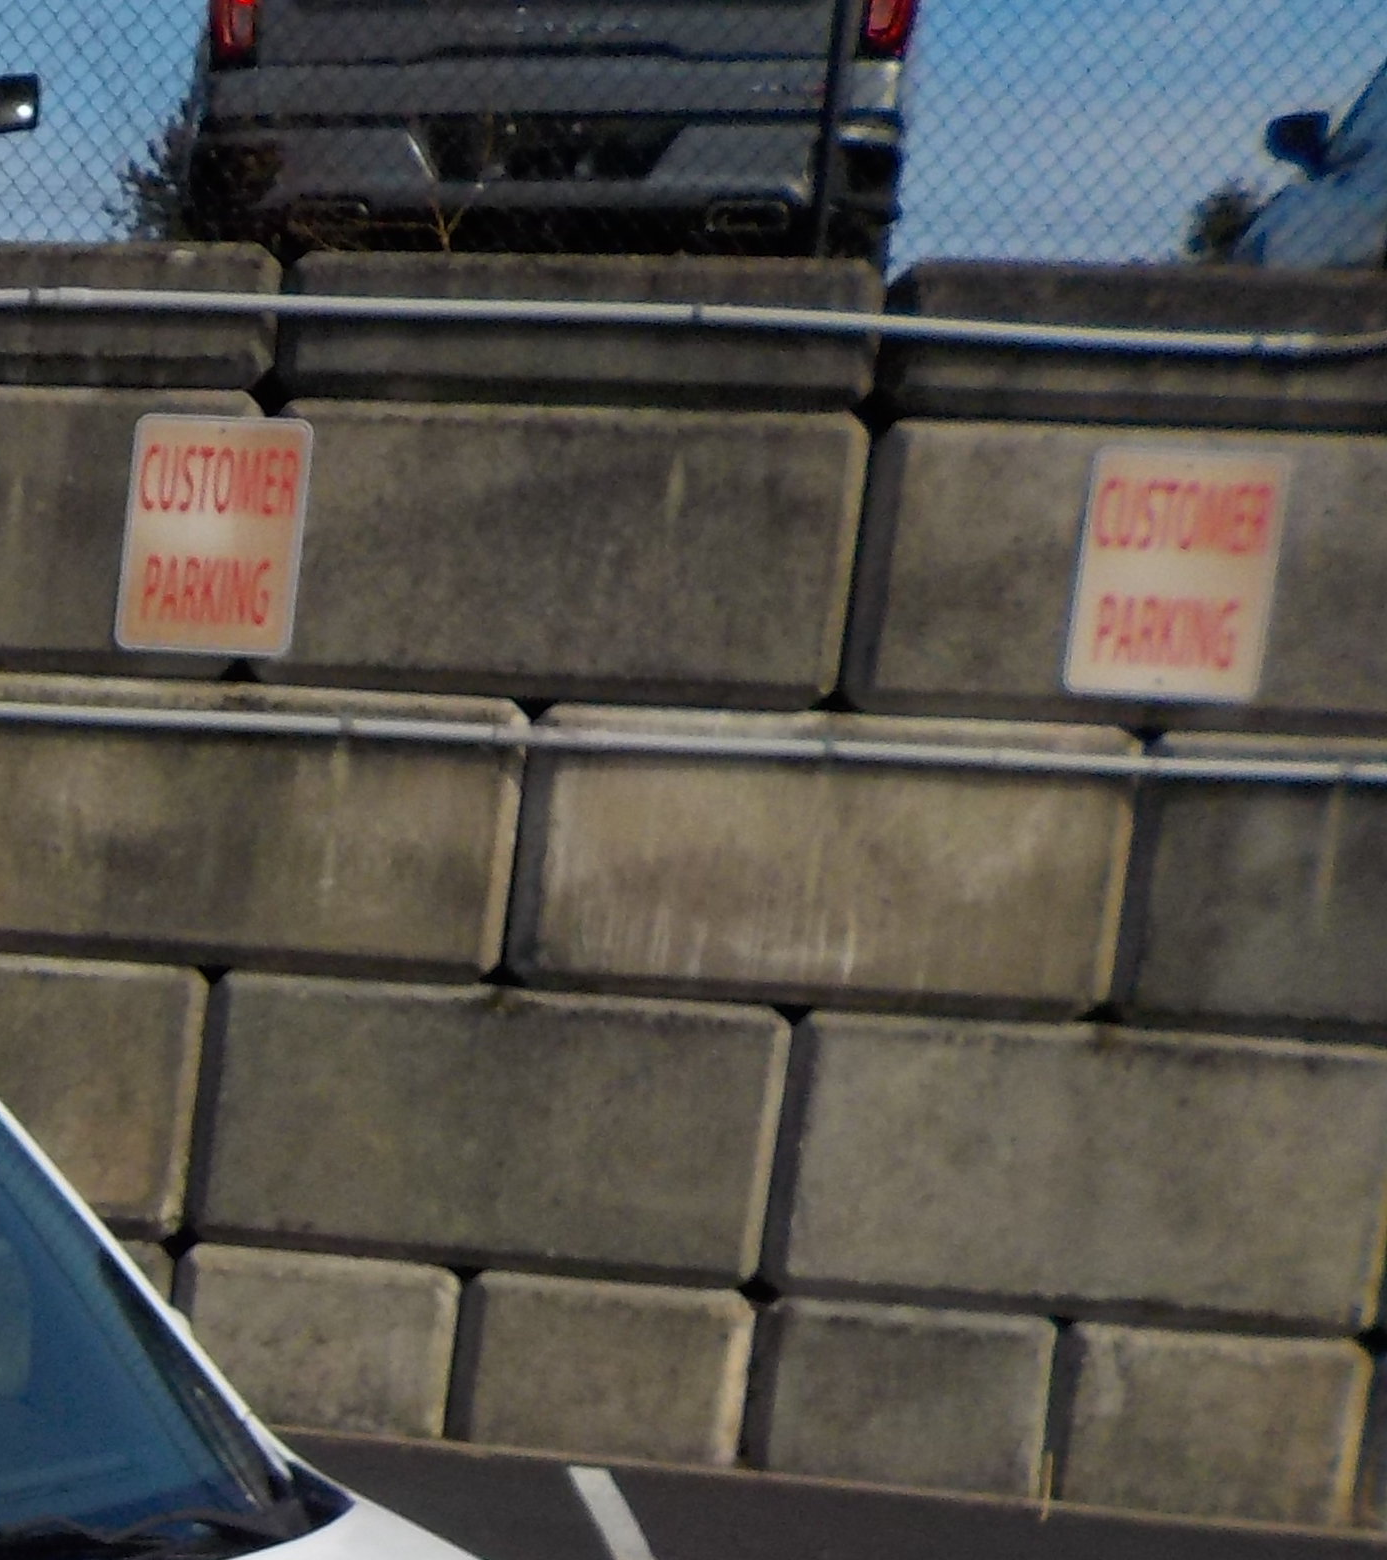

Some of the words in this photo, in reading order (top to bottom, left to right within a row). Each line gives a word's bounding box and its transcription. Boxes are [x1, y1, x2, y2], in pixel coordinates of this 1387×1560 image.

[141, 443, 297, 518] CUSTOMER
[1094, 476, 1274, 558] CUSTOMER
[141, 555, 272, 626] PARKING
[1095, 593, 1241, 670] PARKING
